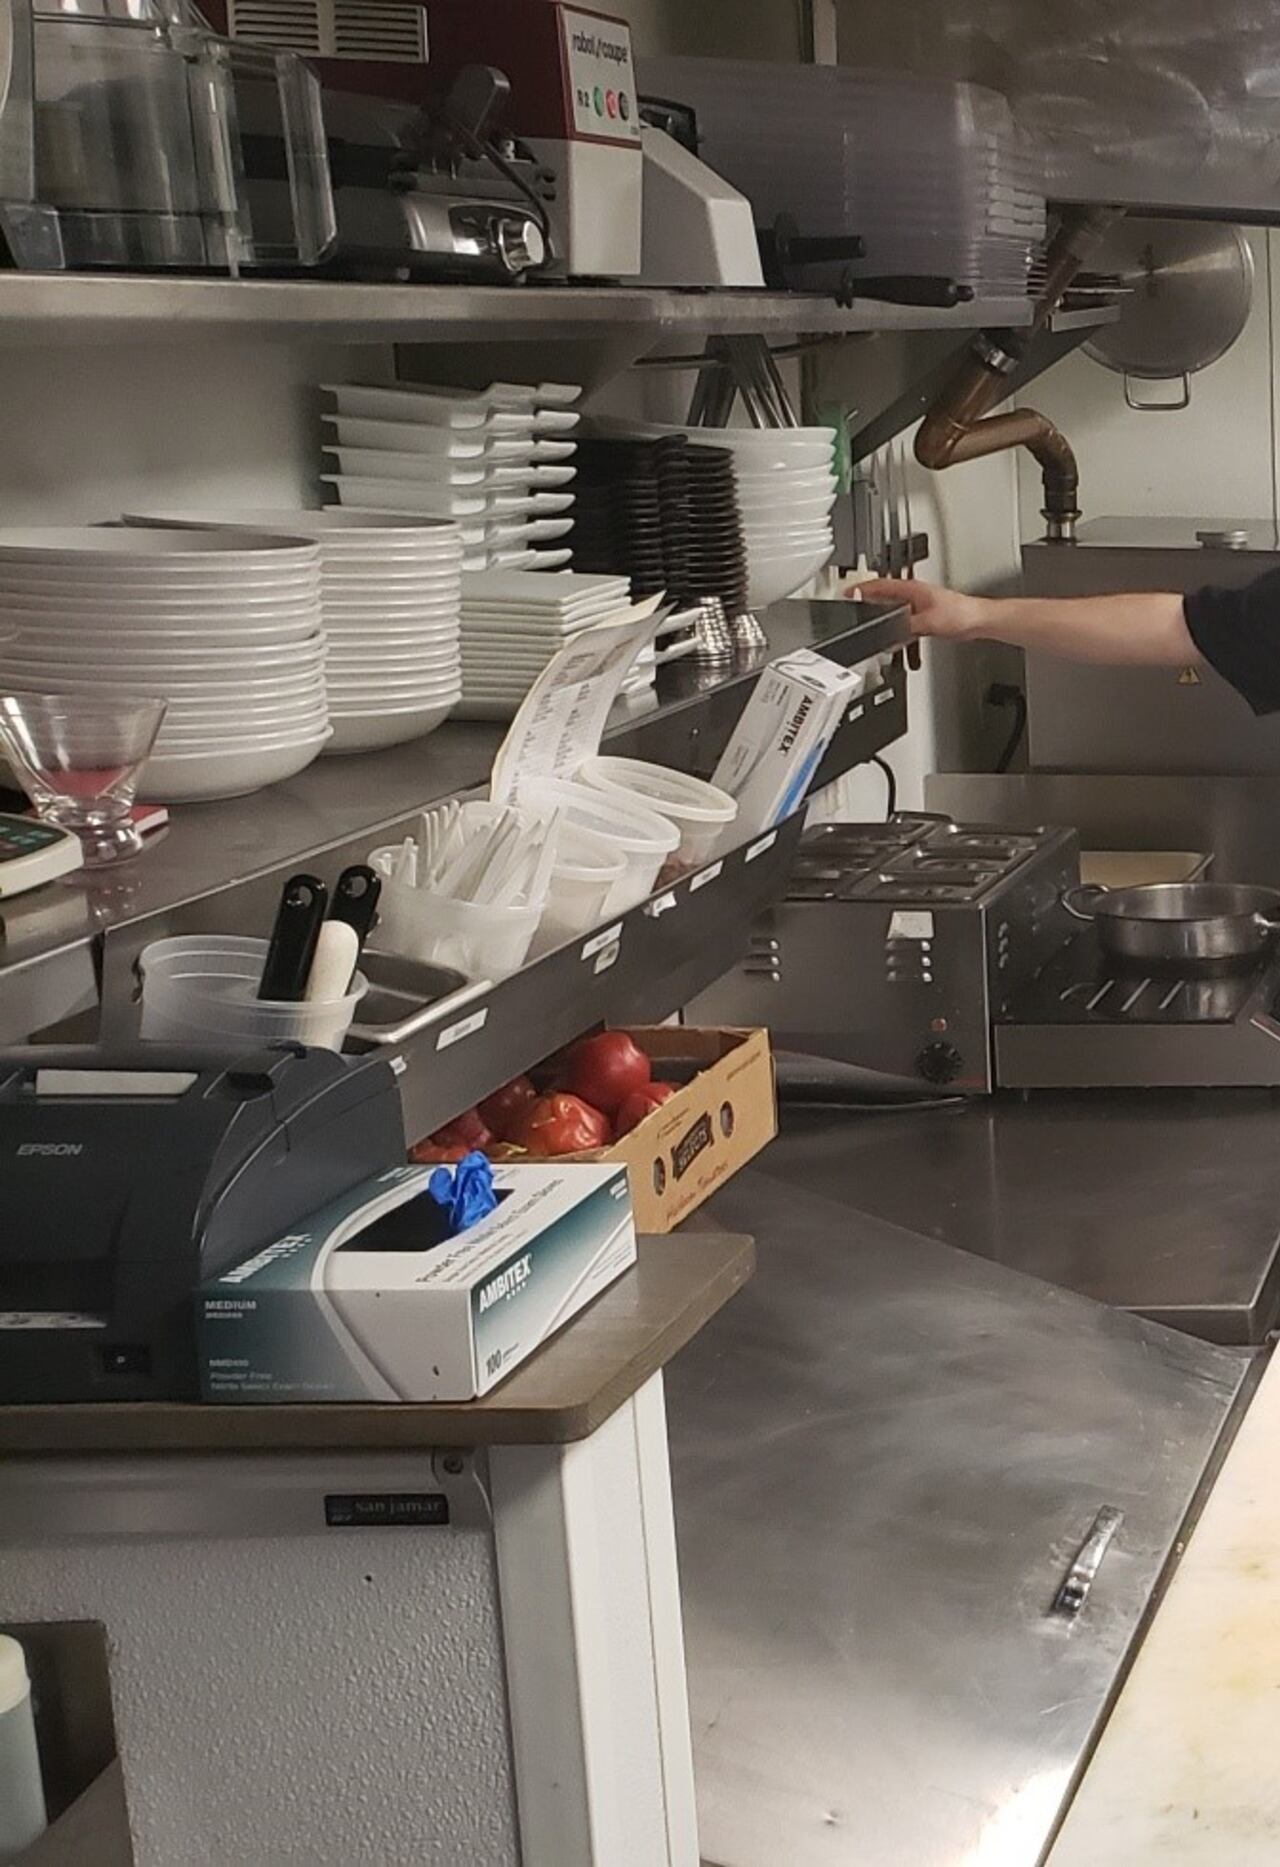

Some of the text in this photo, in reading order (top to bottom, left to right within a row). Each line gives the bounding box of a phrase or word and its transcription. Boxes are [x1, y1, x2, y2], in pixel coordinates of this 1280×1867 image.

[777, 694, 814, 757] AMBITEX
[16, 1143, 83, 1156] EPSON
[219, 1233, 312, 1283] AMBITEX
[205, 1301, 257, 1310] MEDIUM
[479, 1256, 532, 1314] AMBITEX
